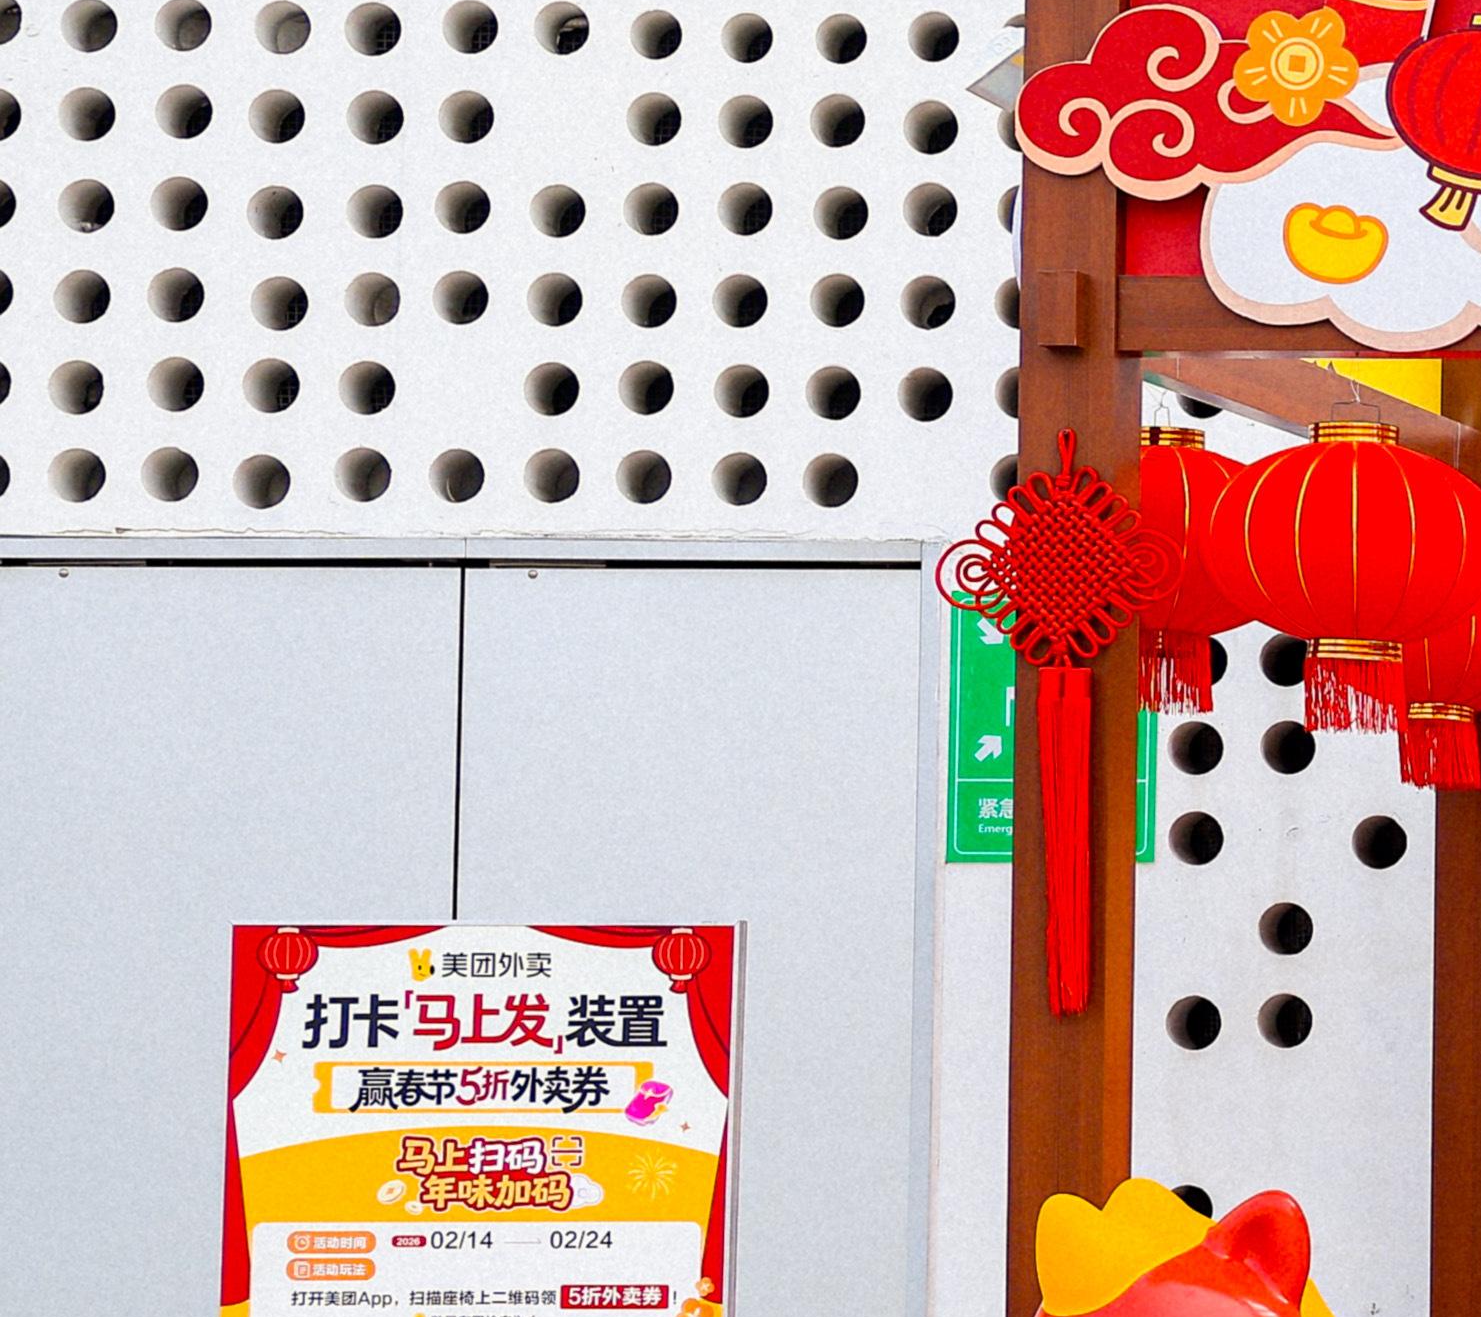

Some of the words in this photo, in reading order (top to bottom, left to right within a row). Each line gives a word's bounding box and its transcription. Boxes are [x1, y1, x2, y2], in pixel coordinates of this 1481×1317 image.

[442, 952, 552, 979] 美团外卖
[349, 1066, 611, 1114] 赢春节5折外卖券
[398, 1137, 546, 1174] 马上扫码
[421, 1174, 572, 1210] 年味加码
[313, 1235, 368, 1251] 活动时间
[395, 1236, 422, 1247] 2026
[430, 1230, 495, 1250] 02/14
[549, 1229, 614, 1250] 02/24
[312, 1263, 367, 1278] 活动玩法
[568, 1285, 662, 1307] 5折外卖券
